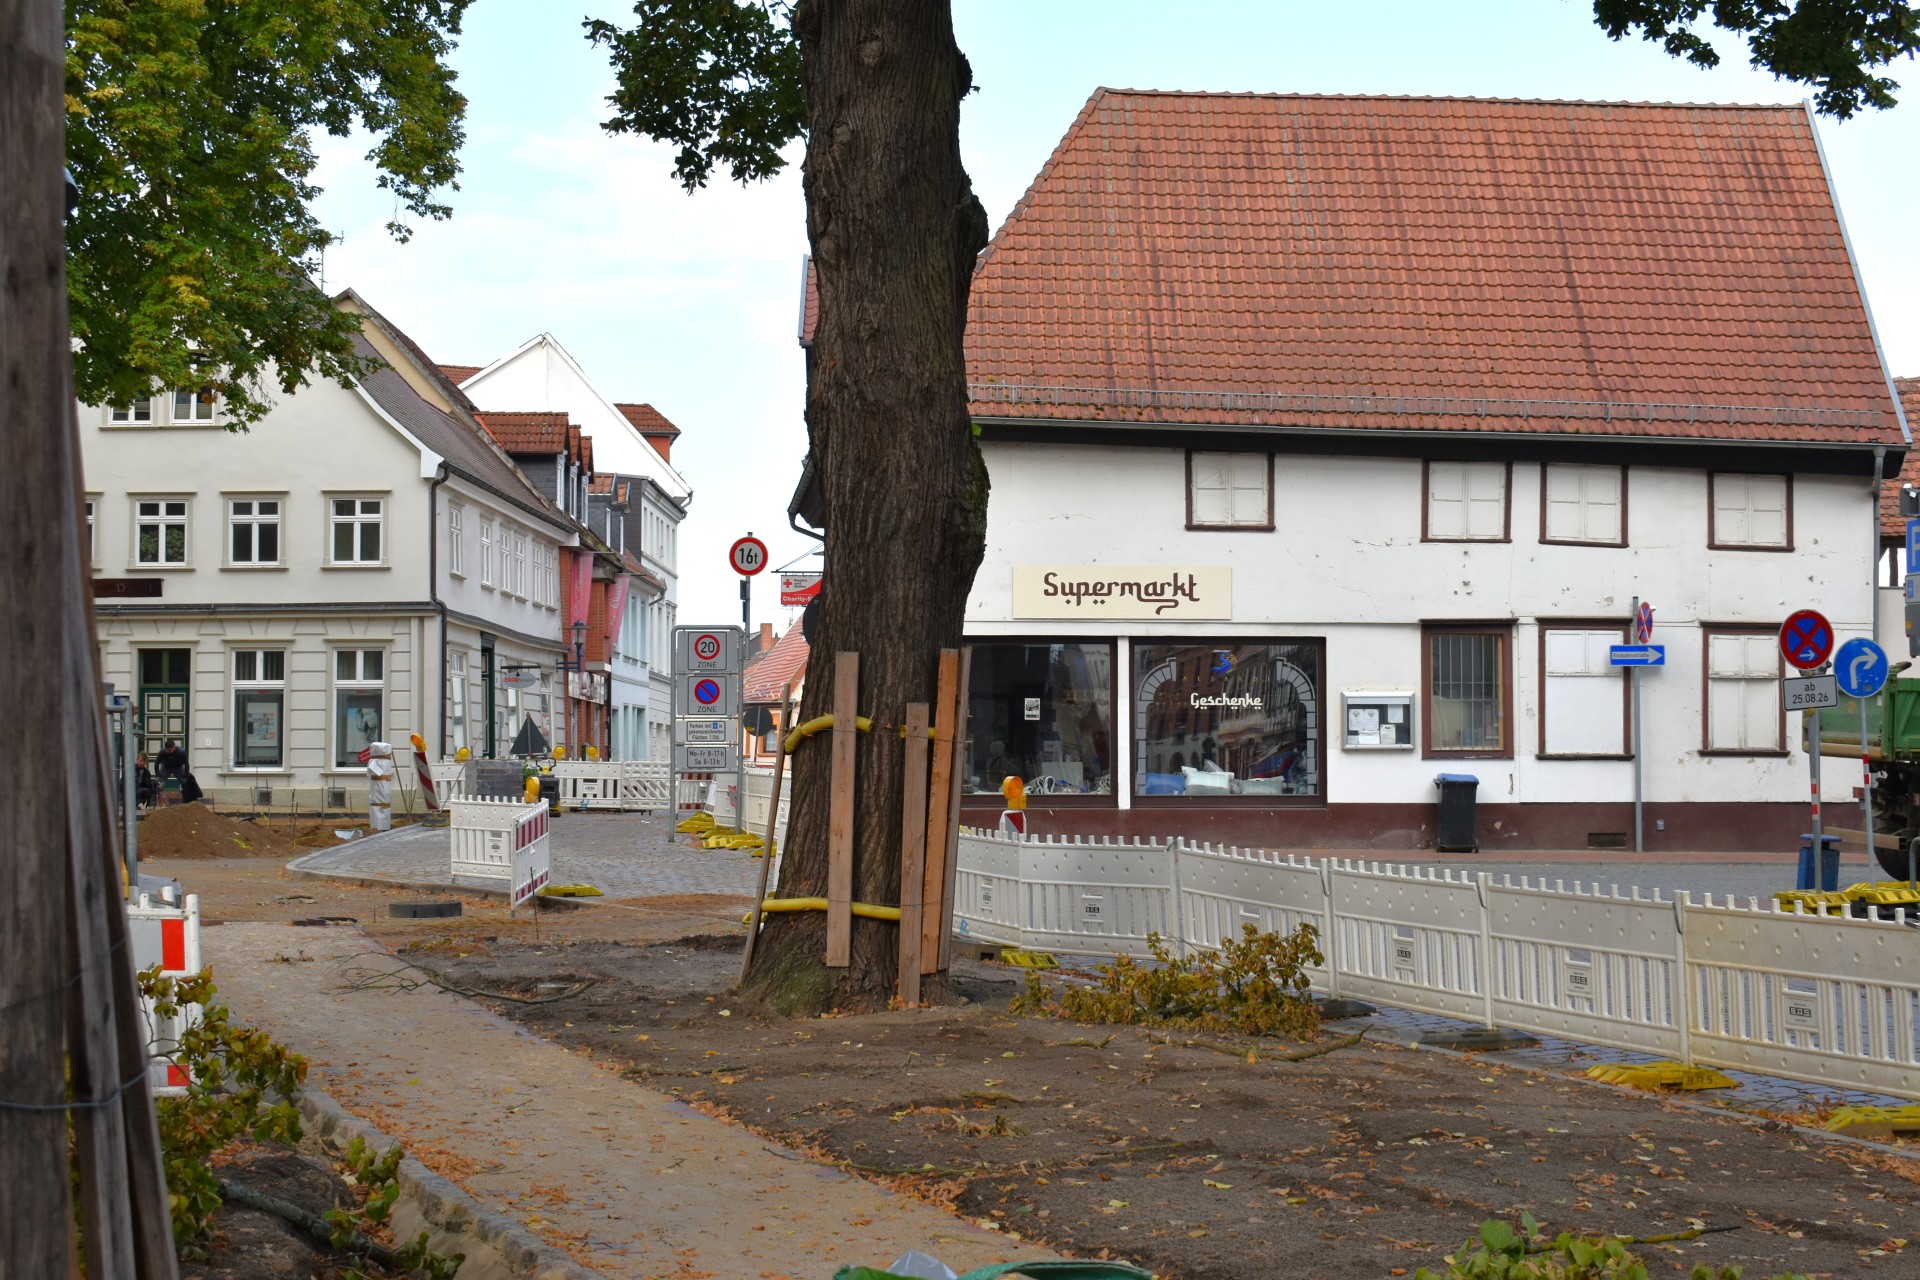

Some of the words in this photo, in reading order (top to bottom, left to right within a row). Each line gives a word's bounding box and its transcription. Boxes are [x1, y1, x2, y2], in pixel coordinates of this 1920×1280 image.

[1043, 572, 1200, 616] Supermarkt
[700, 641, 715, 654] 20
[1804, 682, 1816, 691] ab
[1190, 692, 1263, 709] Geschenke
[1792, 692, 1829, 704] 25.08.26
